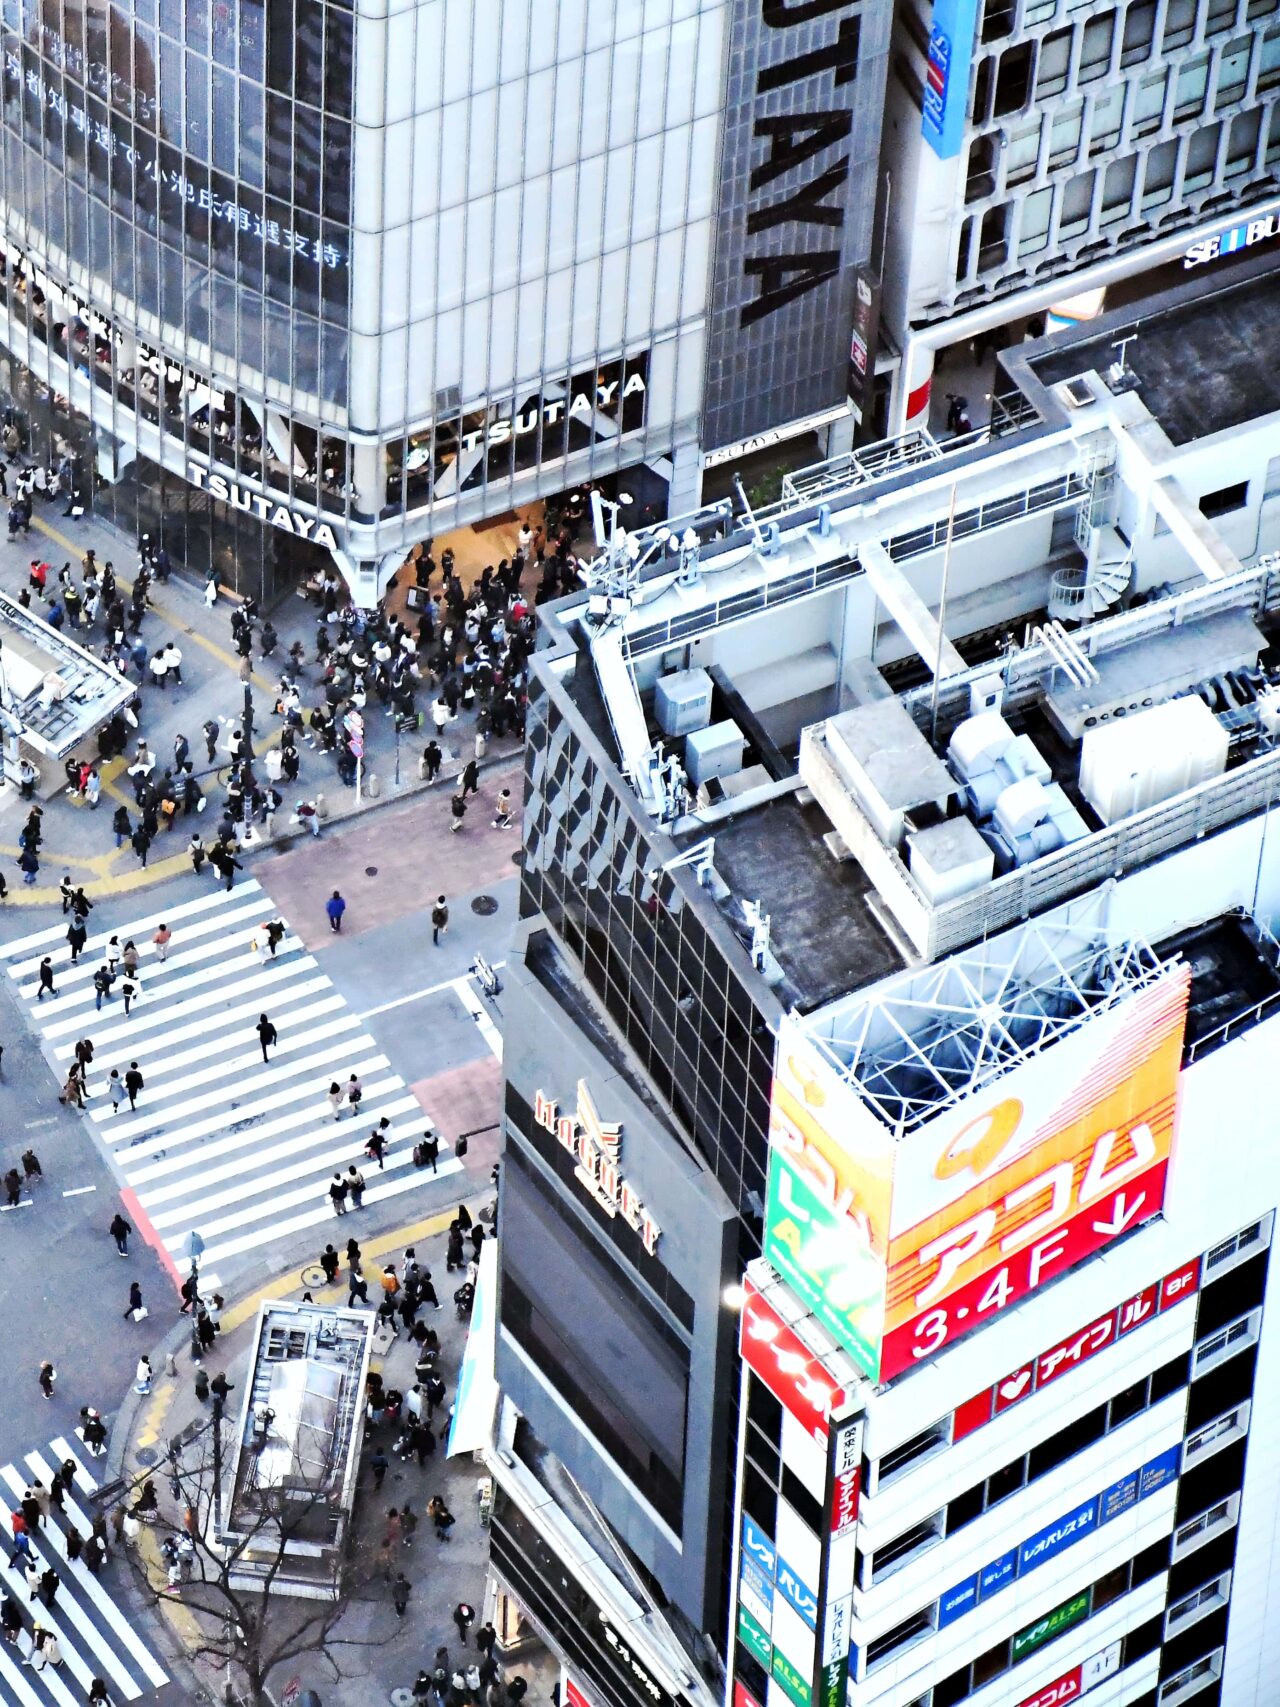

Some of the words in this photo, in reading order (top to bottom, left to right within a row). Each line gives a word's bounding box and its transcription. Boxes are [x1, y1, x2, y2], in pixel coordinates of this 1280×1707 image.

[1184, 215, 1280, 270] SEIBU
[463, 373, 645, 453] TSUTAYA
[187, 462, 337, 551] TSUTAYA
[914, 1122, 1157, 1308] アコム
[1040, 1299, 1152, 1381] アイフル
[1166, 1271, 1193, 1296] 8F
[838, 1481, 855, 1529] アイフル
[773, 1656, 809, 1701] ALSA
